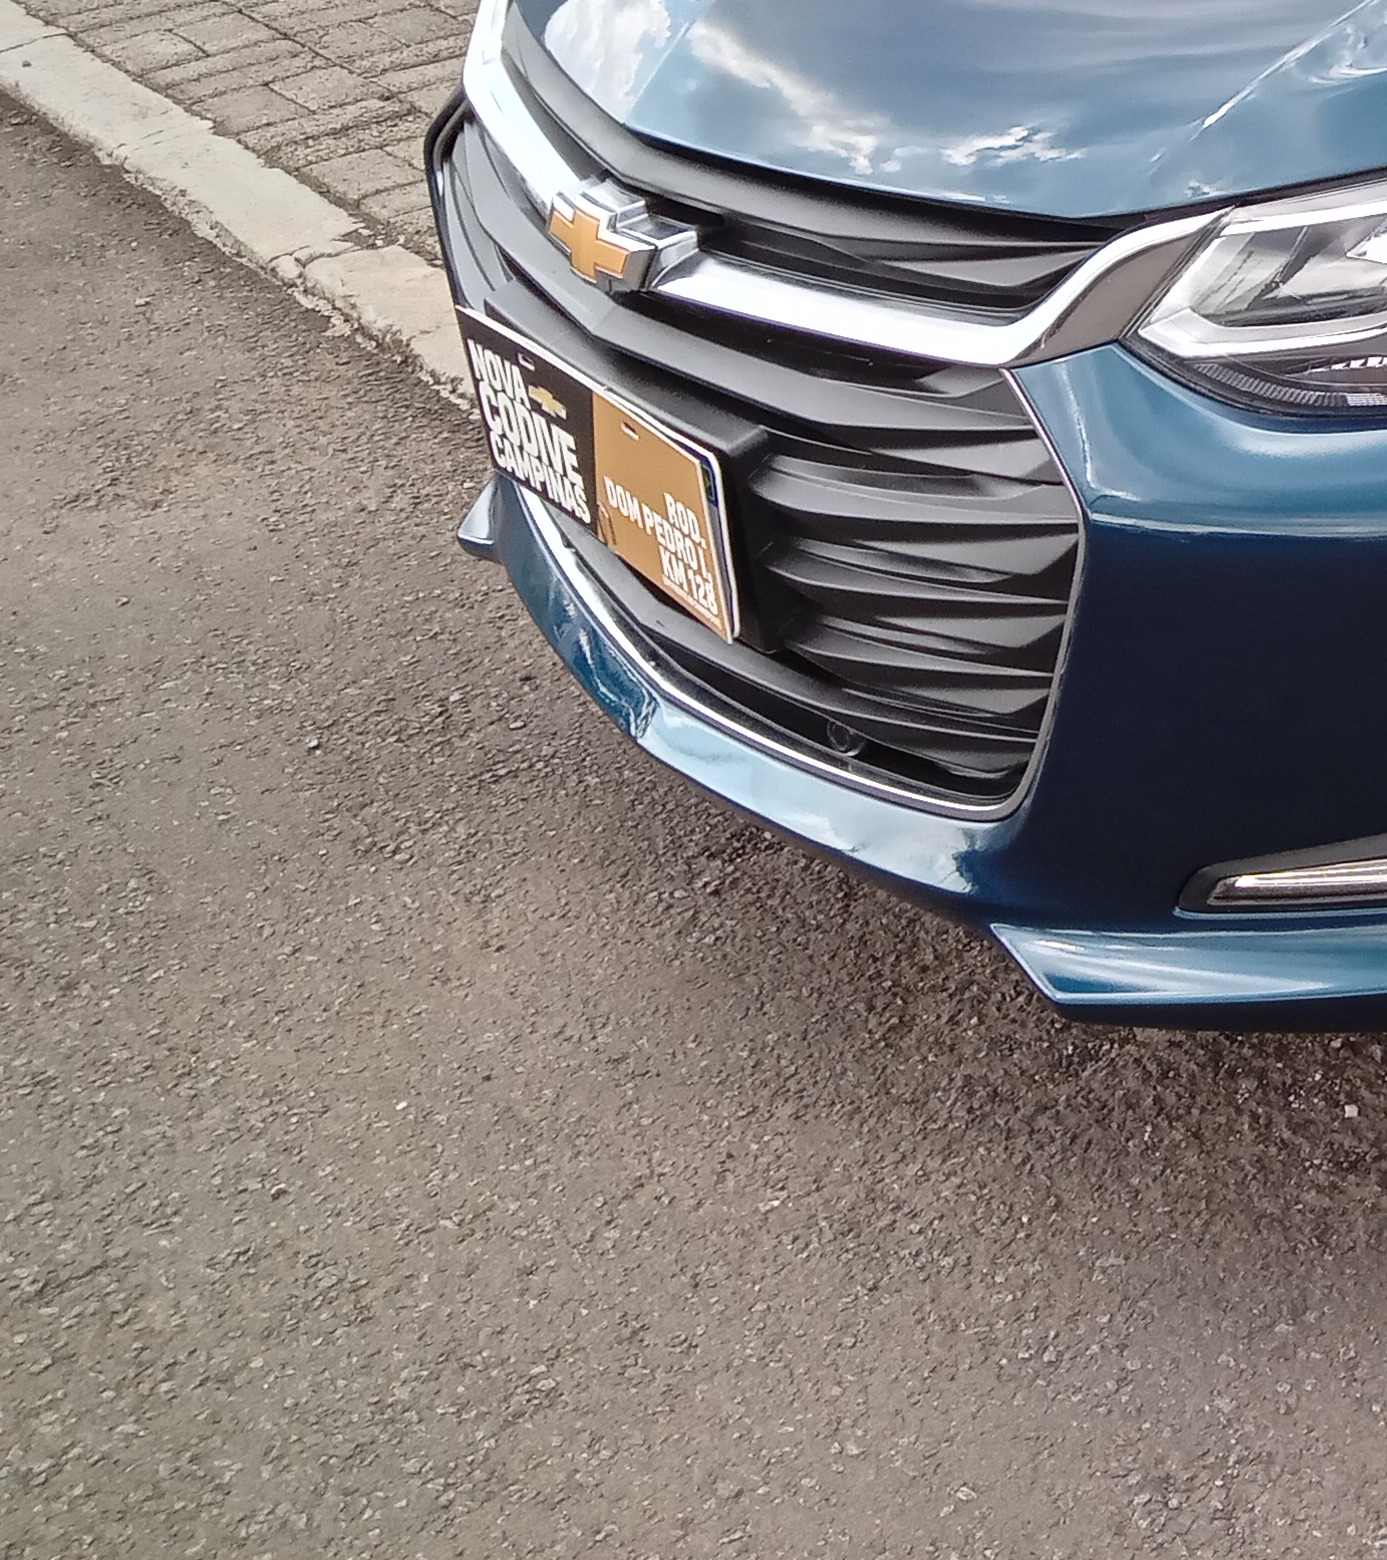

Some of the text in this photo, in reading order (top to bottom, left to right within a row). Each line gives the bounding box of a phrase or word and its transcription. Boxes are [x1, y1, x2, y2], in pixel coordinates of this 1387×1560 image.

[466, 338, 532, 411] NOVA
[479, 381, 585, 490] CODIVE
[490, 430, 591, 524] CAMPINAS
[603, 475, 643, 529] DOM
[641, 503, 698, 571] PEDRO
[659, 545, 688, 592] KM
[688, 569, 718, 616] 128
